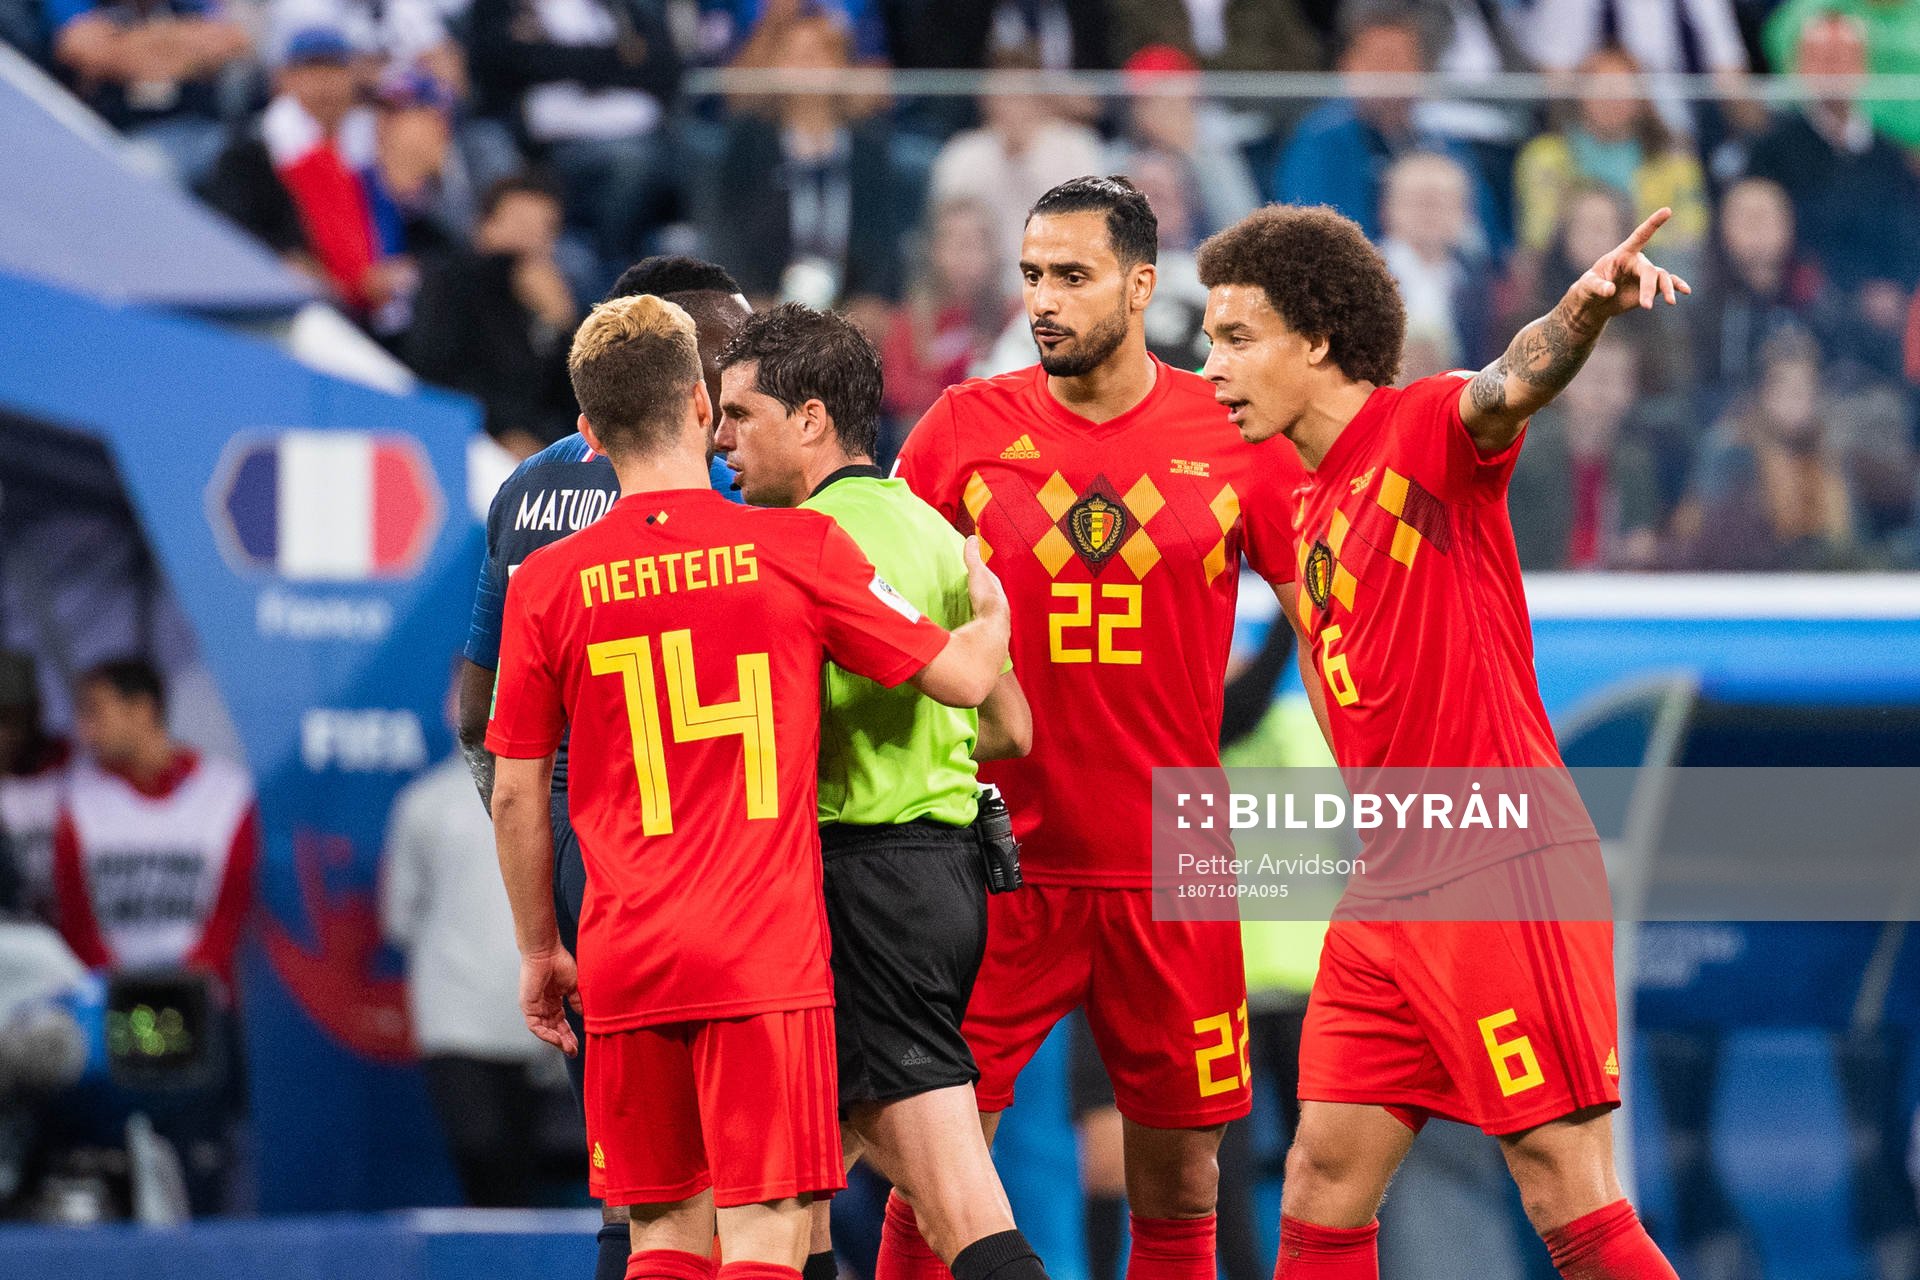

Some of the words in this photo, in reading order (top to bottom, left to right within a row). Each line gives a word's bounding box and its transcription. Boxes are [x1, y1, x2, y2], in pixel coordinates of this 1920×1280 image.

[1000, 449, 1040, 459] adidas
[580, 543, 759, 608] MERTENS
[1049, 583, 1142, 664] 22
[1321, 624, 1359, 707] 6
[587, 629, 778, 836] 14
[1193, 998, 1252, 1097] 22
[1477, 1008, 1545, 1097] 6
